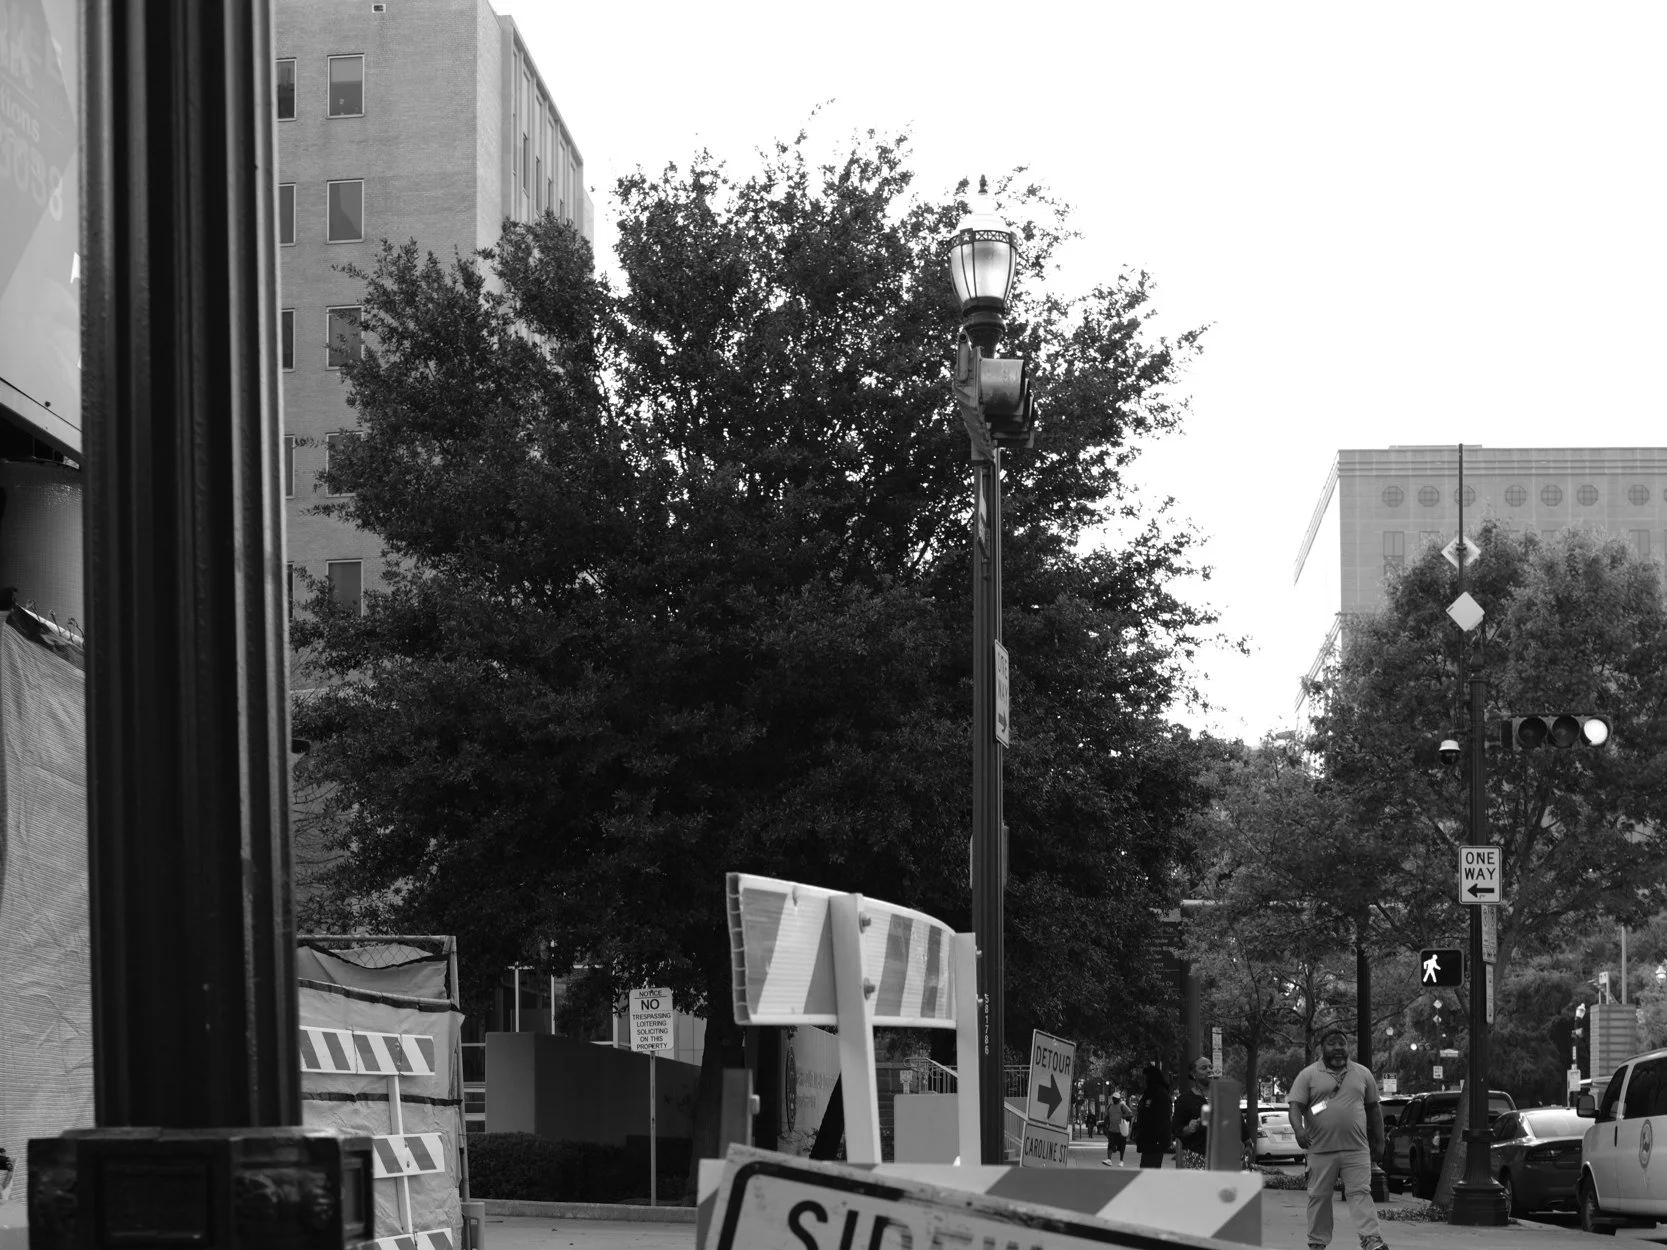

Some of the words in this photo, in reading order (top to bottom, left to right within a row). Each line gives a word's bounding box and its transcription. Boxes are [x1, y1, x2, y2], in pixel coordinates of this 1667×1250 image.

[1465, 851, 1495, 865] ONE
[1464, 867, 1496, 880] WAY
[641, 999, 660, 1010] NO
[632, 1012, 671, 1020] TRESPASSING
[636, 1027, 668, 1035] SOLICITING
[1035, 1045, 1071, 1075] DETOUR
[1024, 1136, 1057, 1162] CAROLINE
[1058, 1144, 1067, 1164] ST
